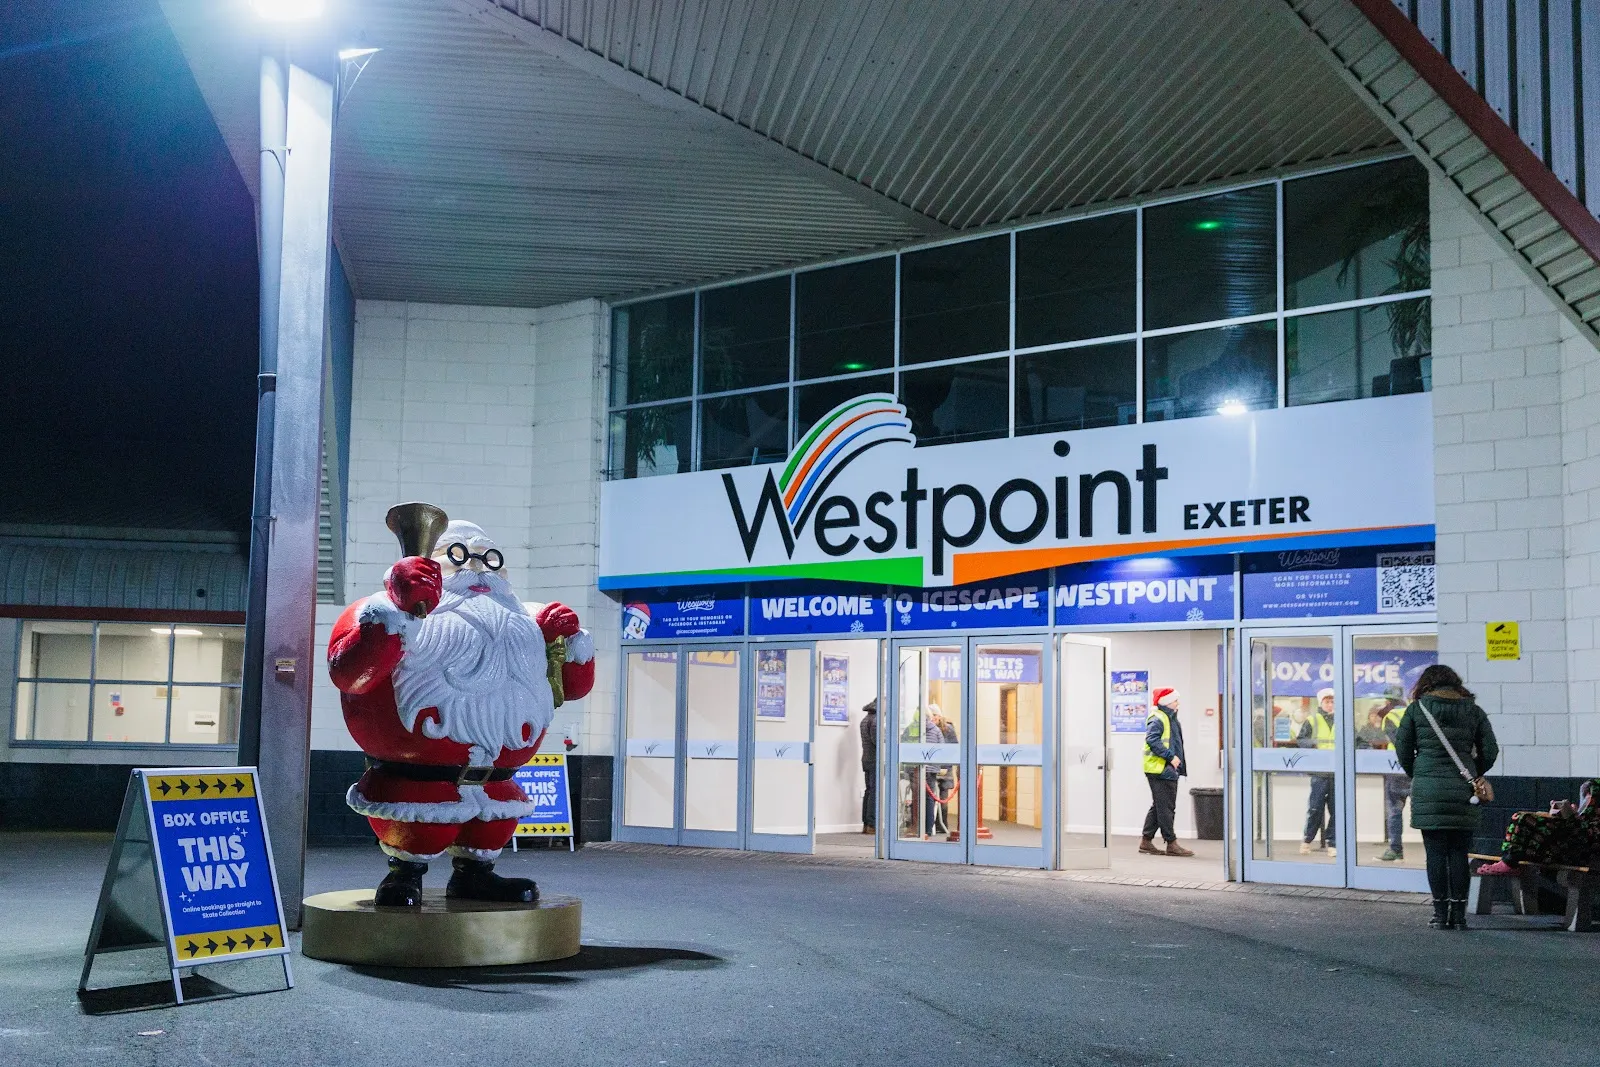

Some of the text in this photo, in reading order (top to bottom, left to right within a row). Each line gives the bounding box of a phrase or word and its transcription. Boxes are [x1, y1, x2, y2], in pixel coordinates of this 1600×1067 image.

[722, 437, 1168, 575] Westpoint
[1183, 495, 1312, 531] EXETER
[1297, 579, 1350, 587] INFORMATION
[762, 594, 873, 618] WELCOME
[922, 586, 1039, 613] ICESCAPE
[1055, 577, 1218, 607] WESTPOINT
[1262, 600, 1360, 609] WWW.ICESCAPEWESTPOINT.COM
[994, 669, 1024, 680] WAY
[521, 781, 557, 794] THIS
[163, 810, 250, 828] BOX OFFICE
[178, 834, 245, 863] THIS
[181, 861, 250, 892] WAY
[182, 905, 201, 913] Online
[201, 903, 227, 911] bookings
[234, 900, 256, 908] straight
[202, 909, 246, 919] Skate Collection
